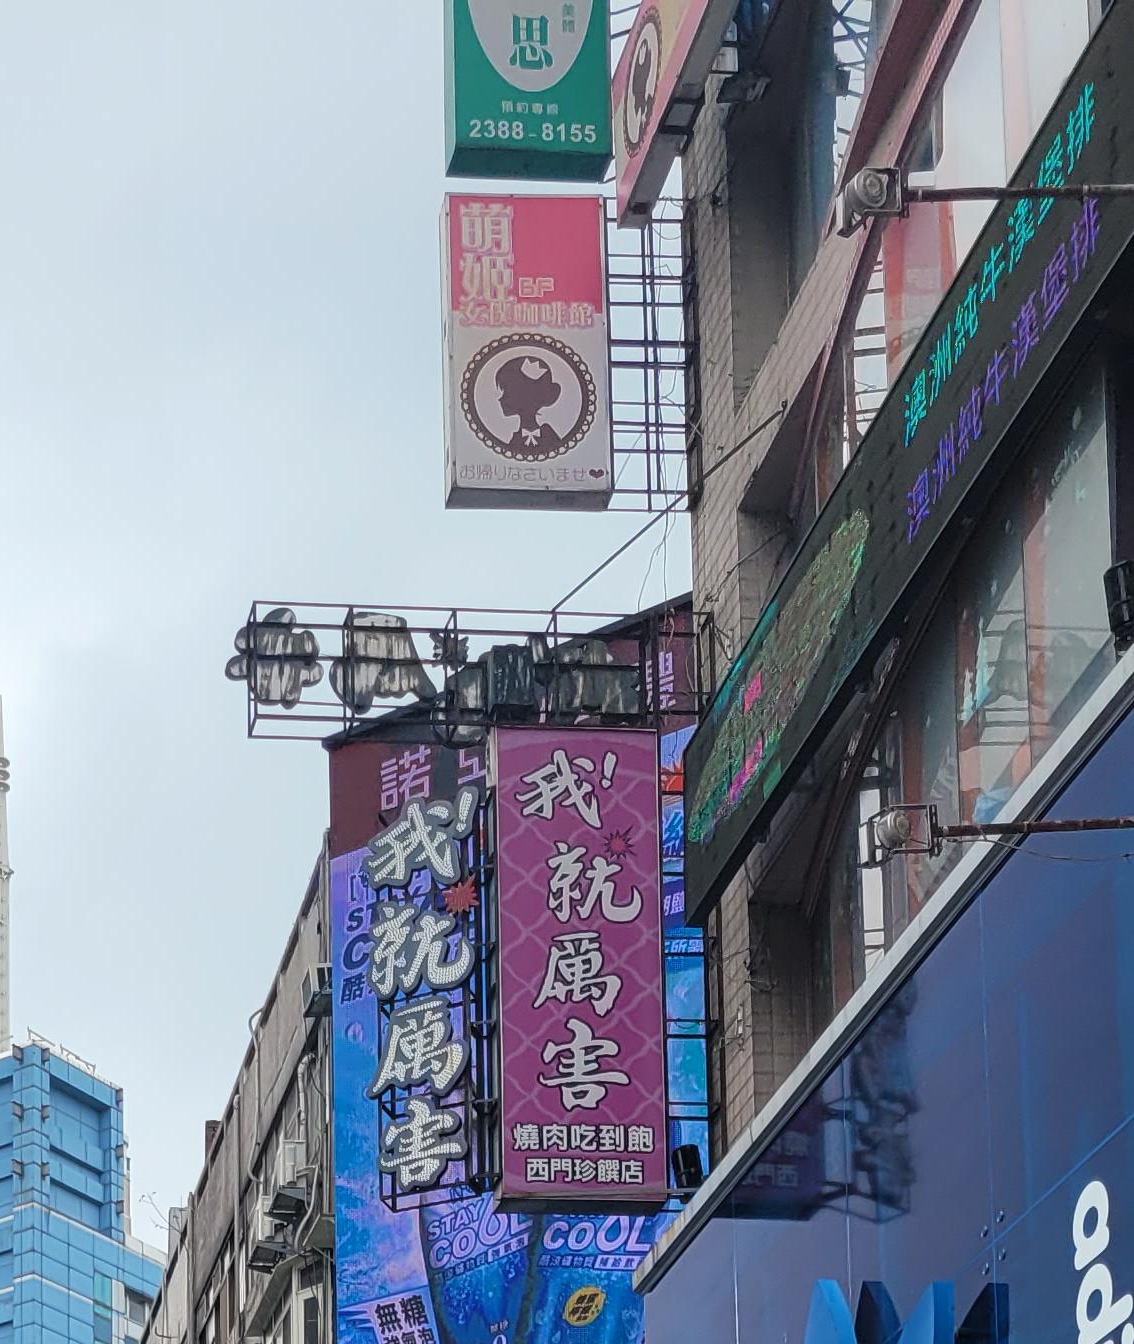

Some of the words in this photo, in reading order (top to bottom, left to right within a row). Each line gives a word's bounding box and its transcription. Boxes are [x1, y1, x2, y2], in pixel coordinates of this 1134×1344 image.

[468, 119, 596, 144] 2388-8155
[459, 463, 587, 483] お帰りなさいませ
[512, 1122, 654, 1153] 燒肉吃到飽
[525, 1158, 644, 1184] 西門珍饌店
[427, 1202, 486, 1241] STAY
[543, 1215, 653, 1252] COOL
[374, 1294, 427, 1333] 無糖
